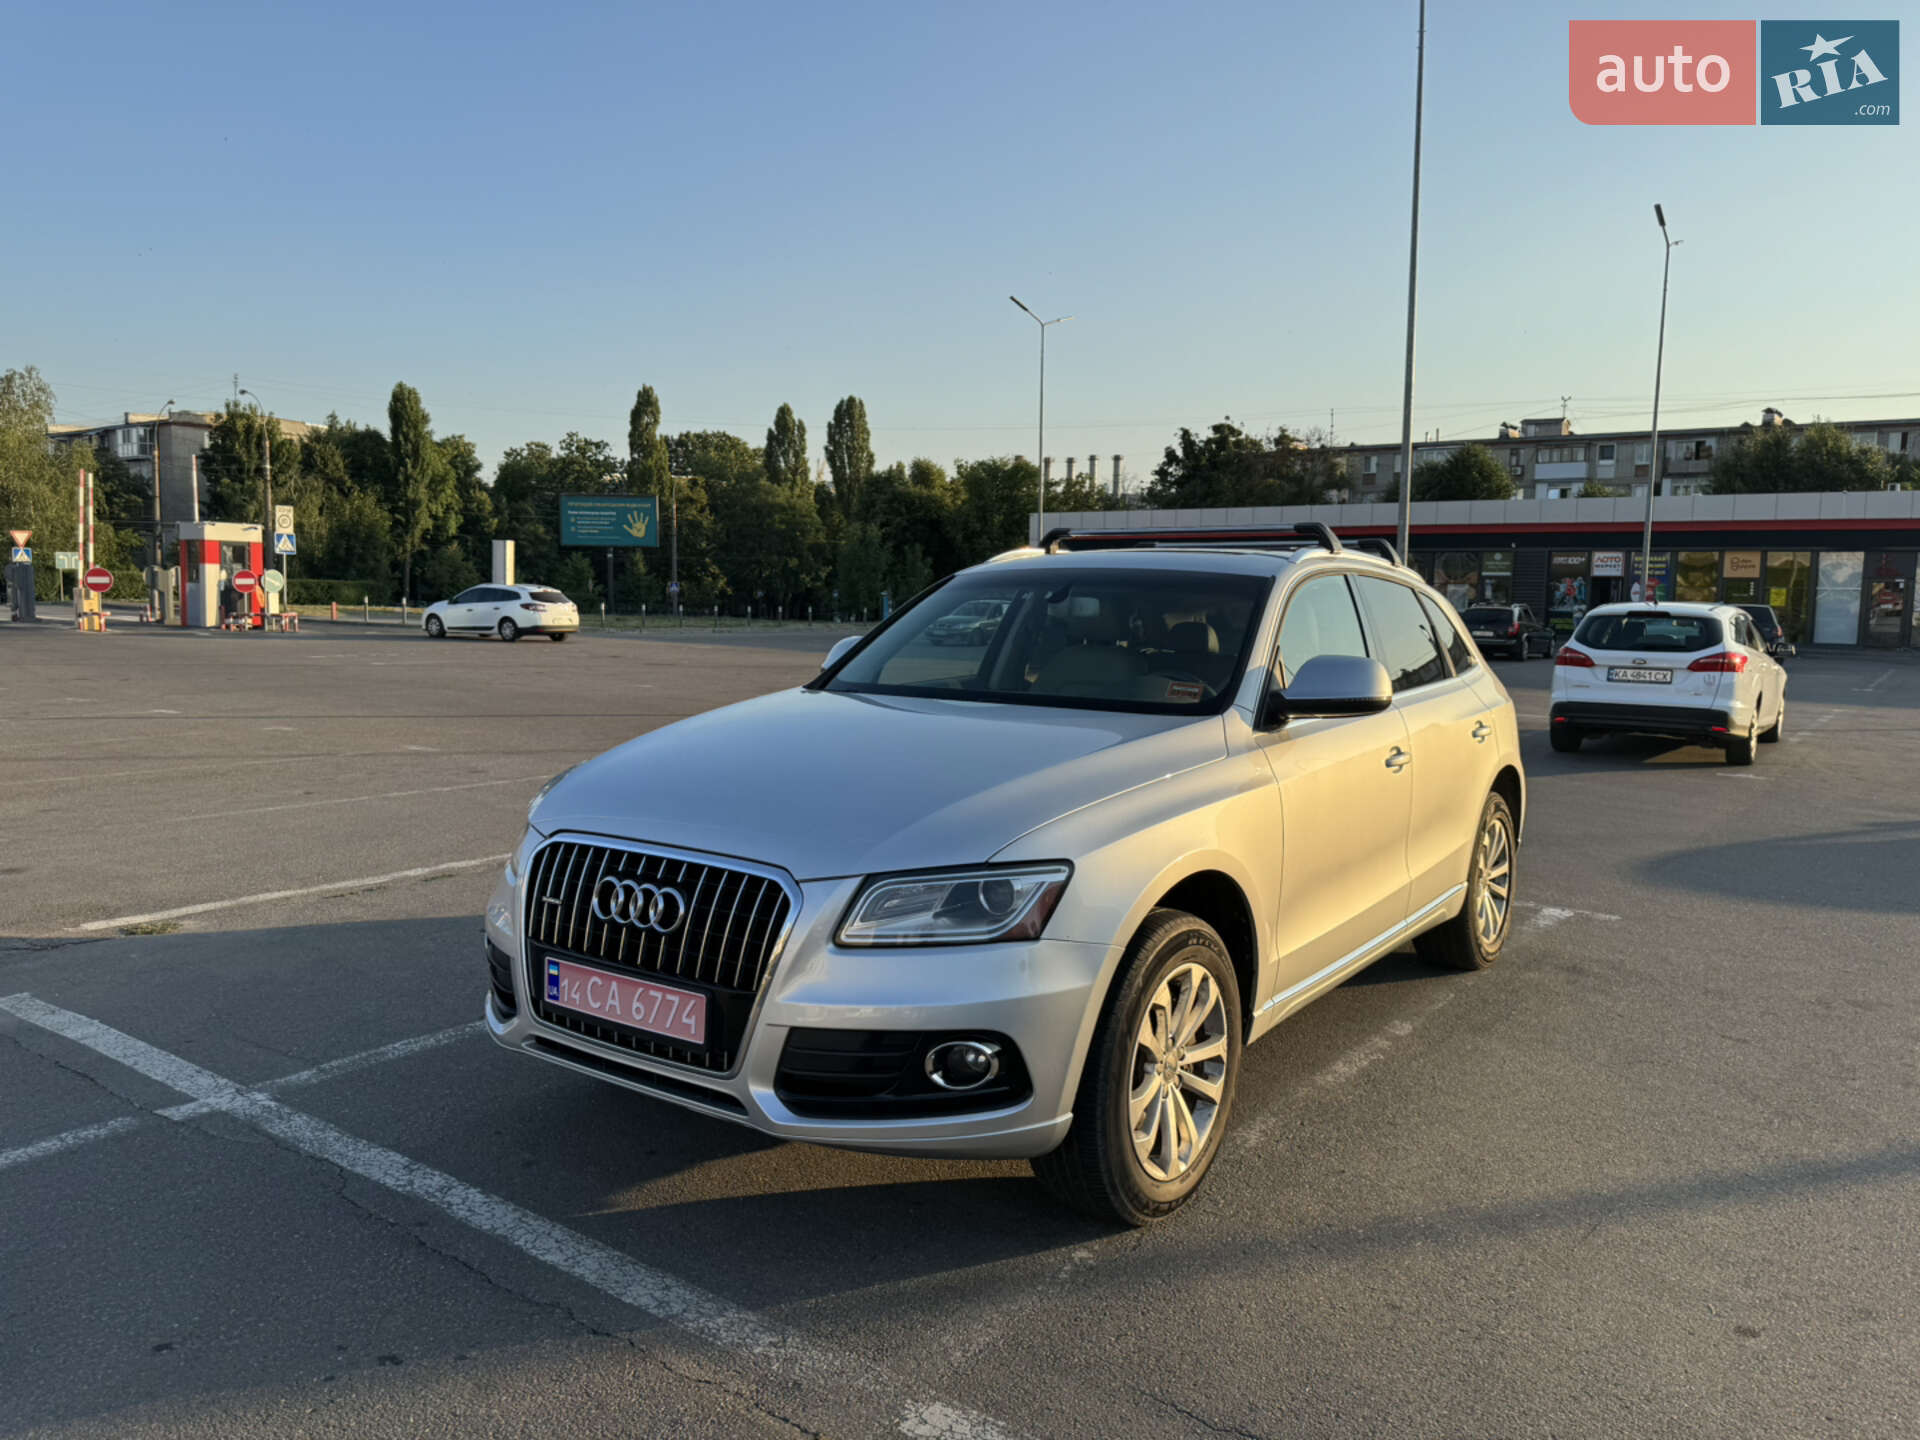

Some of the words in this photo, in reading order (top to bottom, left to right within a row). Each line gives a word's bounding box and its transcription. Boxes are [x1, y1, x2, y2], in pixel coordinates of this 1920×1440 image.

[1614, 669, 1629, 680] KA
[1631, 670, 1652, 680] 4841
[1654, 671, 1669, 681] CX
[631, 988, 696, 1034] 6774
